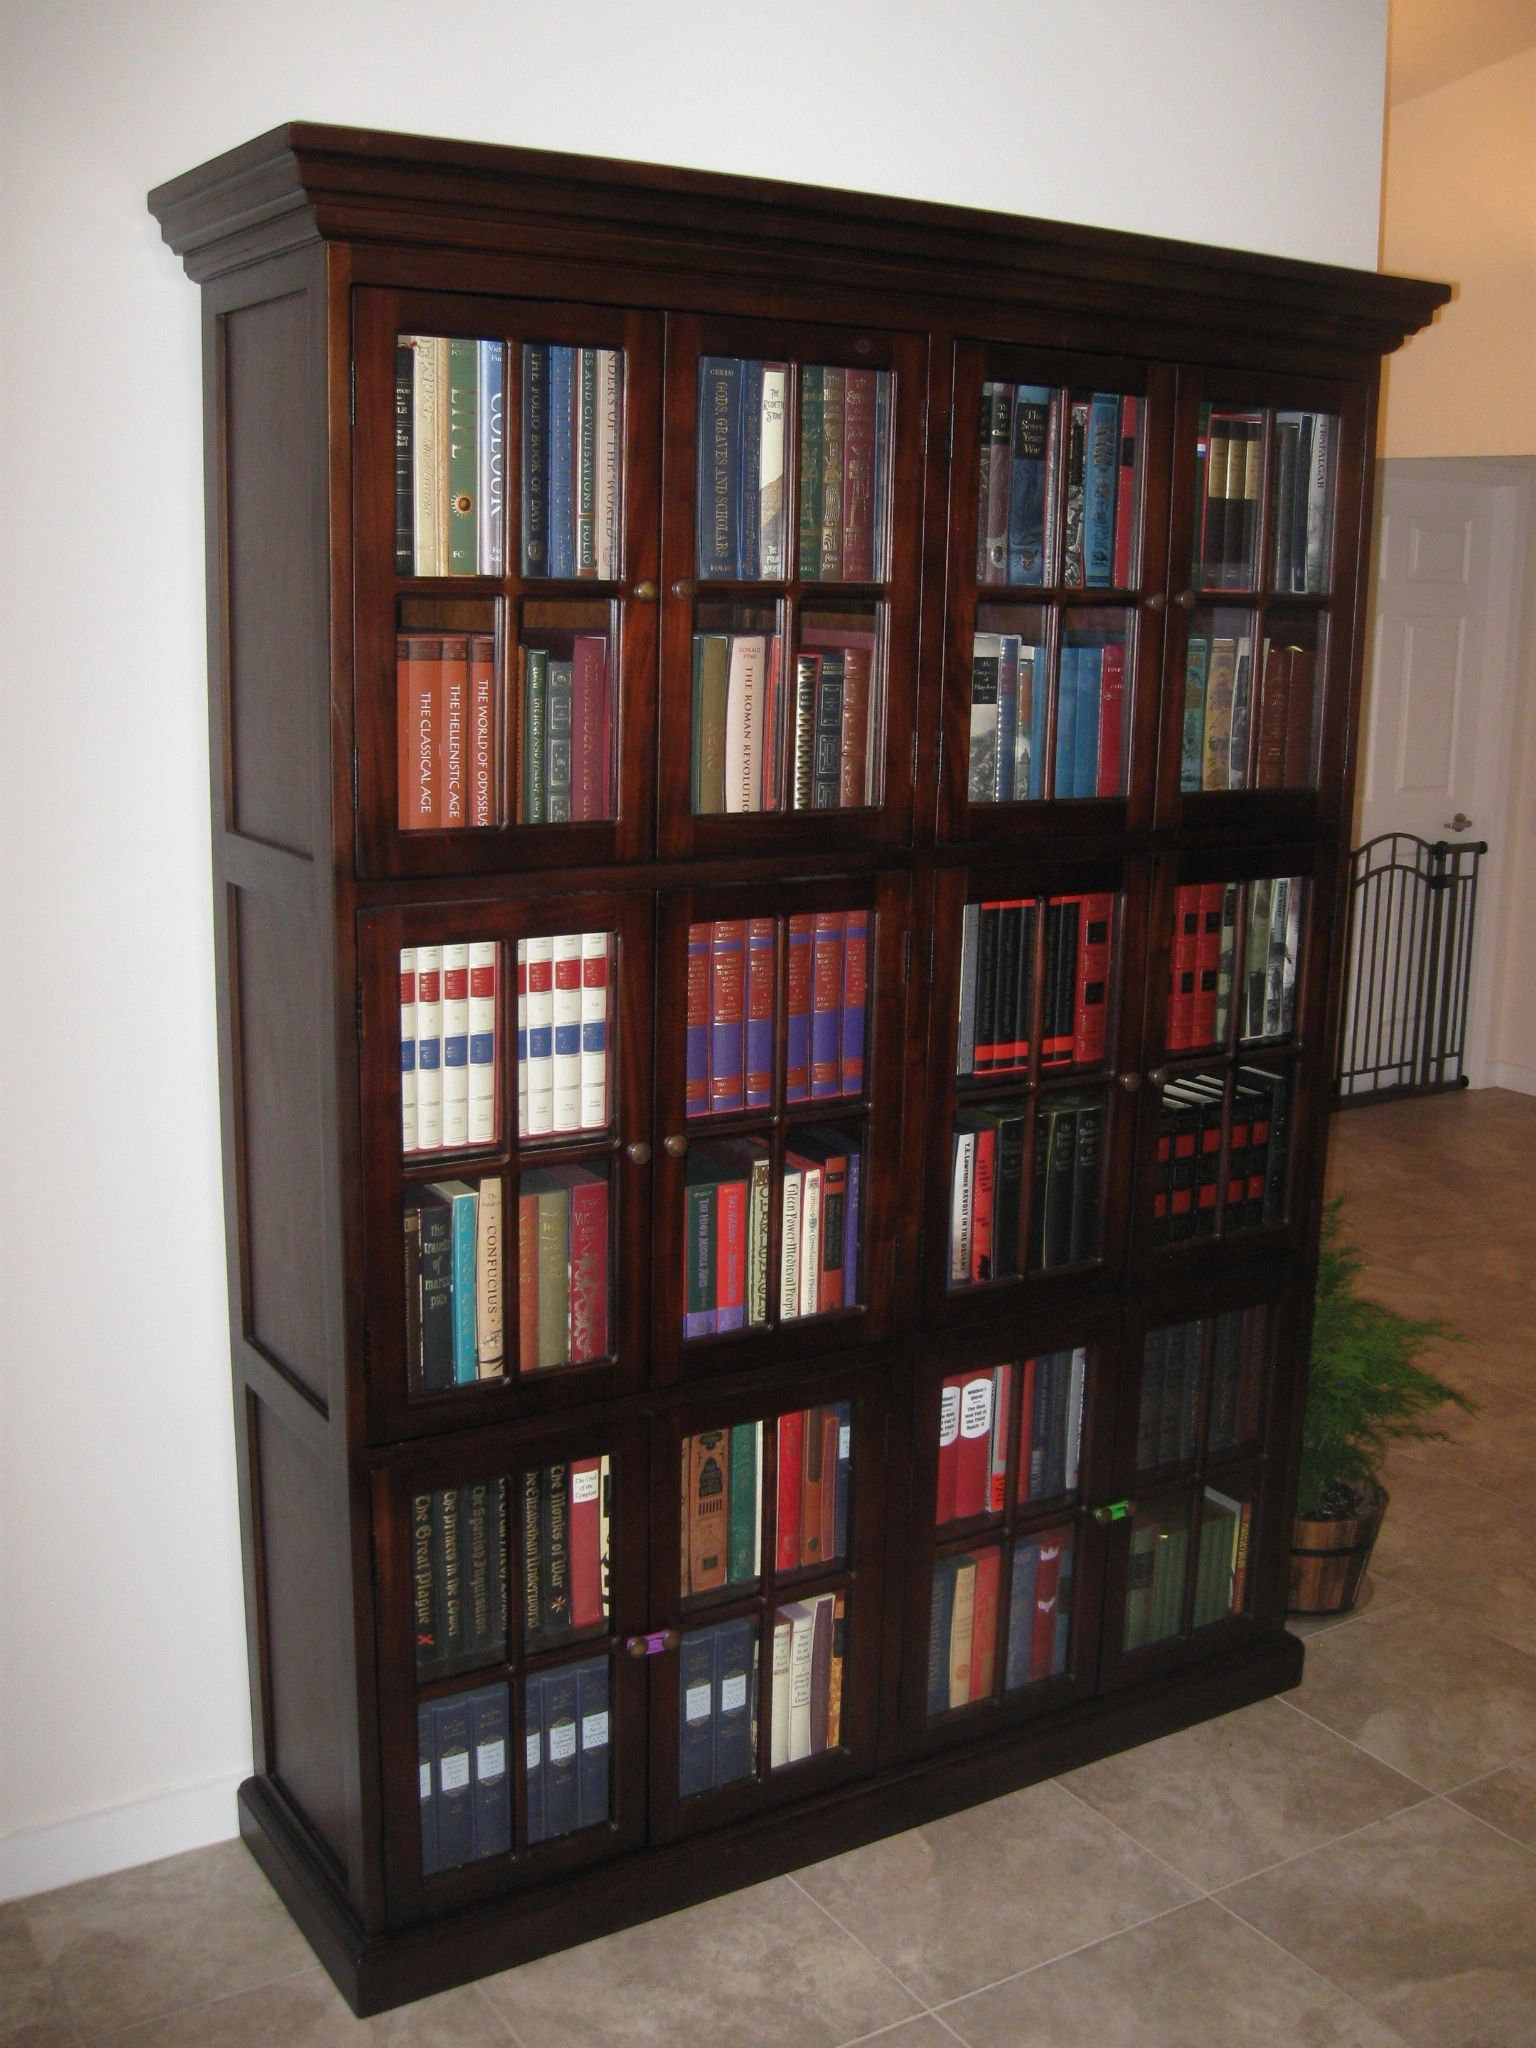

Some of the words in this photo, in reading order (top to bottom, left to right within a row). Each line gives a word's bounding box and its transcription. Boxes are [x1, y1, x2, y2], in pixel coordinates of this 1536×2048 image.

[531, 352, 542, 381] THE
[584, 371, 593, 401] AND
[713, 381, 728, 415] GODS,
[530, 386, 541, 430] FOLIO
[607, 411, 617, 432] OF
[530, 434, 541, 472] BOOK
[715, 418, 728, 465] GRAVES
[1317, 423, 1327, 489] TRAFALGAR
[582, 406, 592, 510] CIVILISATIONS
[531, 476, 541, 494] OF
[715, 469, 728, 494] AND
[531, 499, 541, 532] DAYS
[715, 496, 728, 557] SCHOLARS
[582, 524, 592, 565] FOLIO
[478, 680, 489, 703] THE
[745, 666, 753, 690] THE
[420, 692, 431, 717] THE
[450, 684, 460, 709] THE
[533, 698, 543, 713] THE
[477, 706, 488, 750] WORLD
[533, 715, 542, 735] SIEGE
[744, 695, 753, 739] ROMAN
[420, 719, 431, 784] CLASSICAL
[449, 712, 460, 789] HELLENISTIC
[478, 752, 488, 768] OF
[533, 737, 542, 758] AND
[741, 744, 751, 812] REVOLUTIO
[420, 786, 431, 813] AGE
[449, 791, 459, 818] AGE
[477, 771, 488, 827] ODYSSEUS
[786, 1183, 799, 1211] Eileen
[487, 1226, 497, 1314] CONFUCIUS
[783, 1288, 796, 1317] People
[551, 1465, 566, 1489] The
[415, 1495, 431, 1521] The
[442, 1491, 457, 1512] The
[526, 1487, 540, 1555] Elizabethan
[551, 1494, 565, 1540] Monks
[415, 1526, 432, 1569] Great
[551, 1544, 566, 1556] of
[552, 1558, 566, 1588] War
[415, 1572, 432, 1624] Plague
